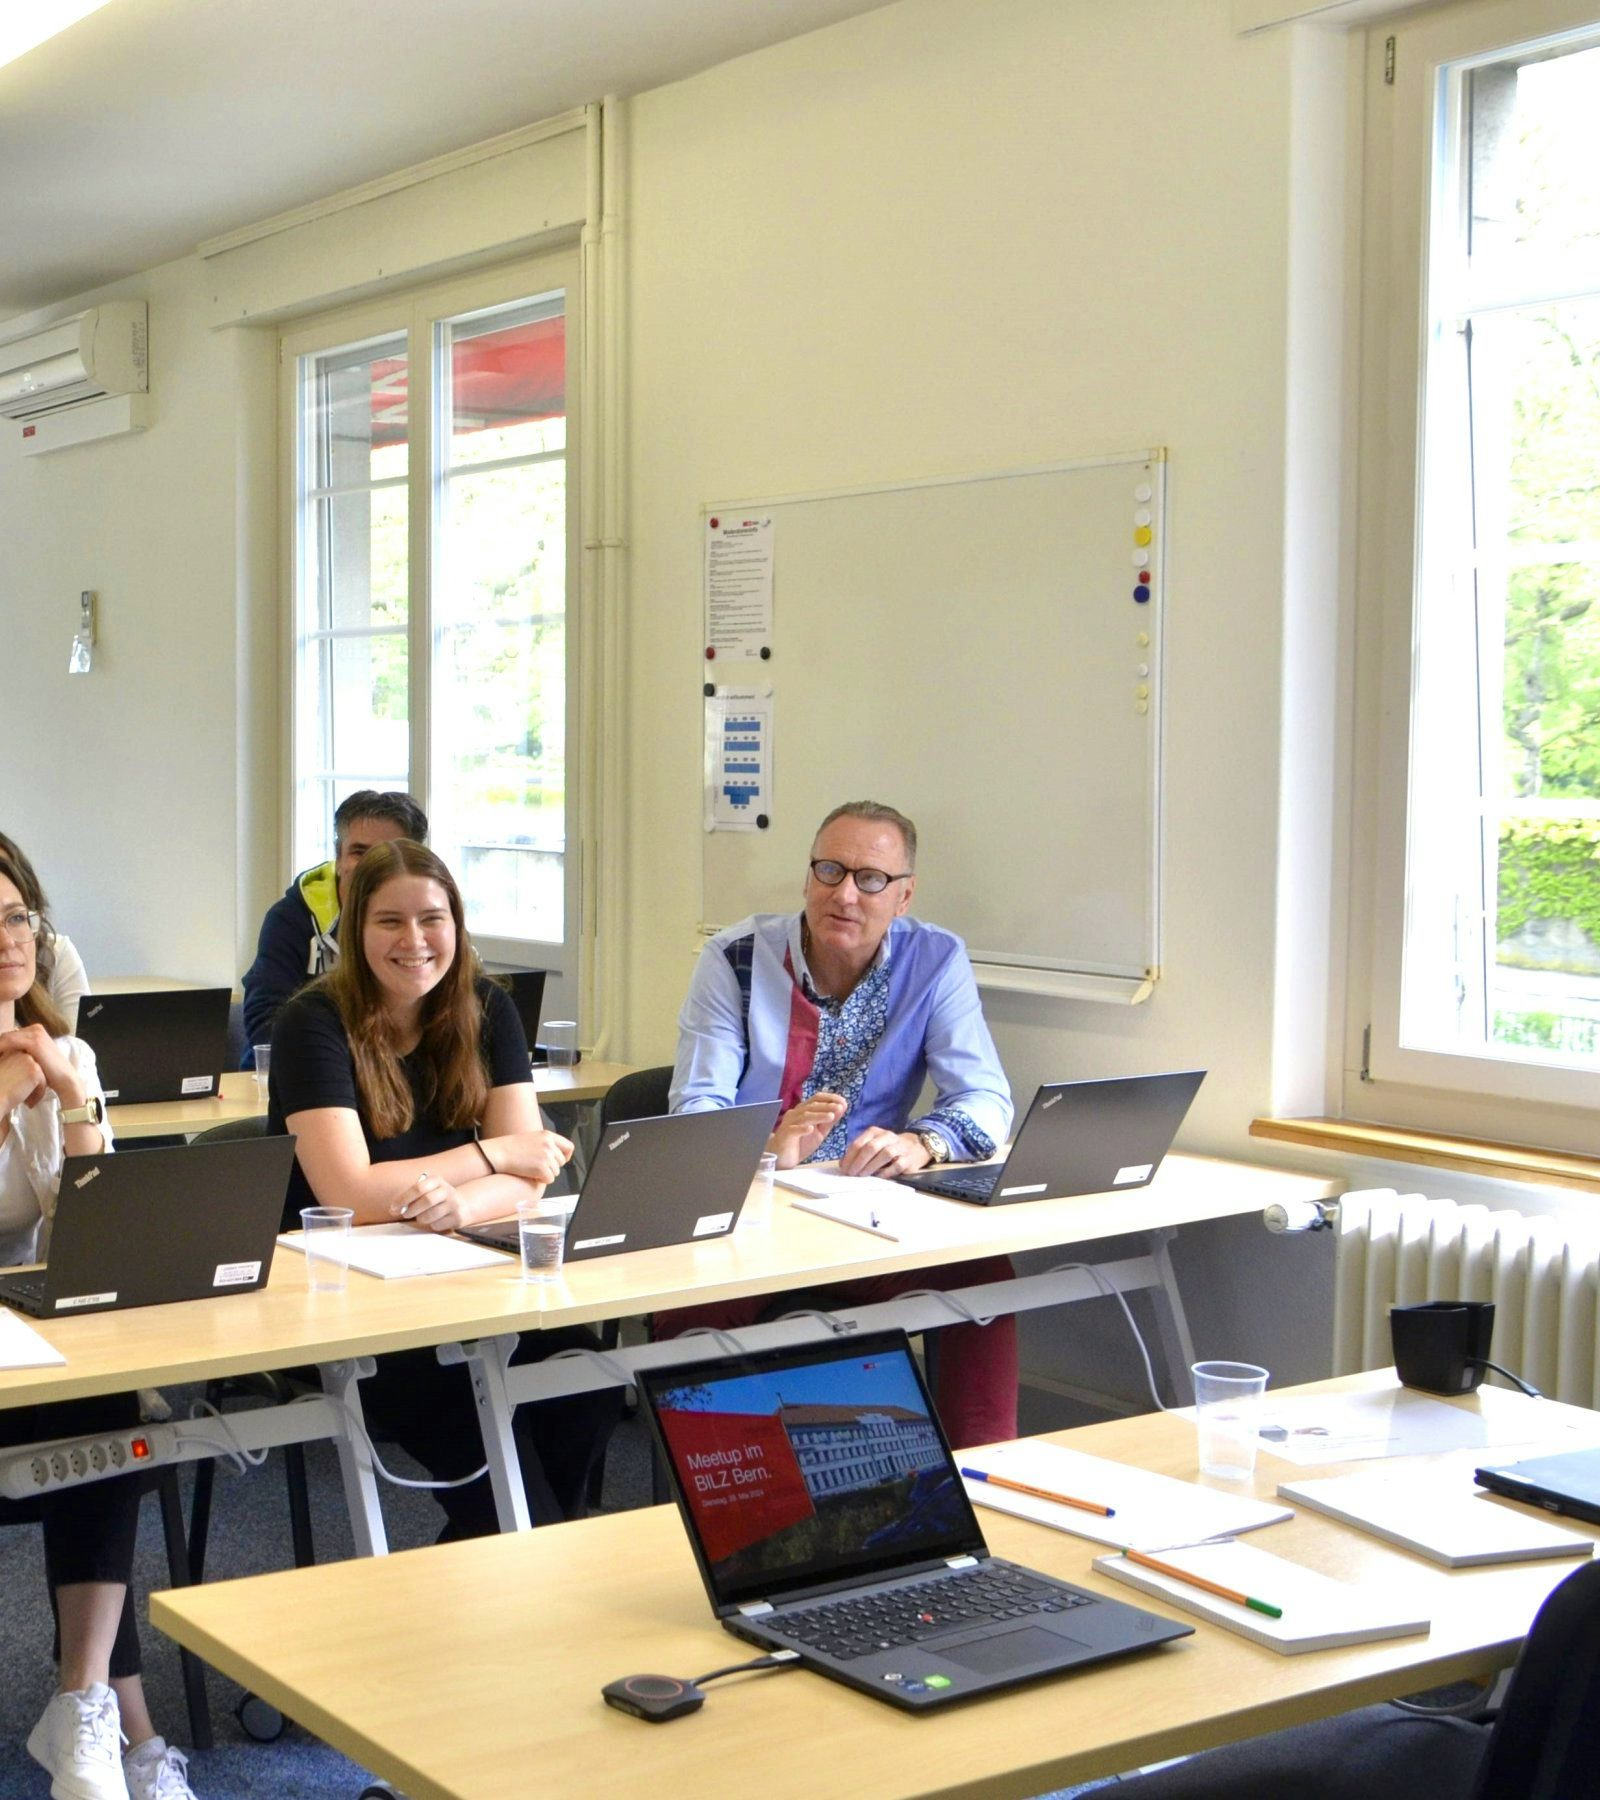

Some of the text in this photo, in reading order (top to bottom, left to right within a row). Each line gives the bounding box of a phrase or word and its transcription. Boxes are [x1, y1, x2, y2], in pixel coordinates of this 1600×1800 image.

[686, 1444, 764, 1470] Meetup im
[694, 1466, 772, 1492] BILZ Bern.
